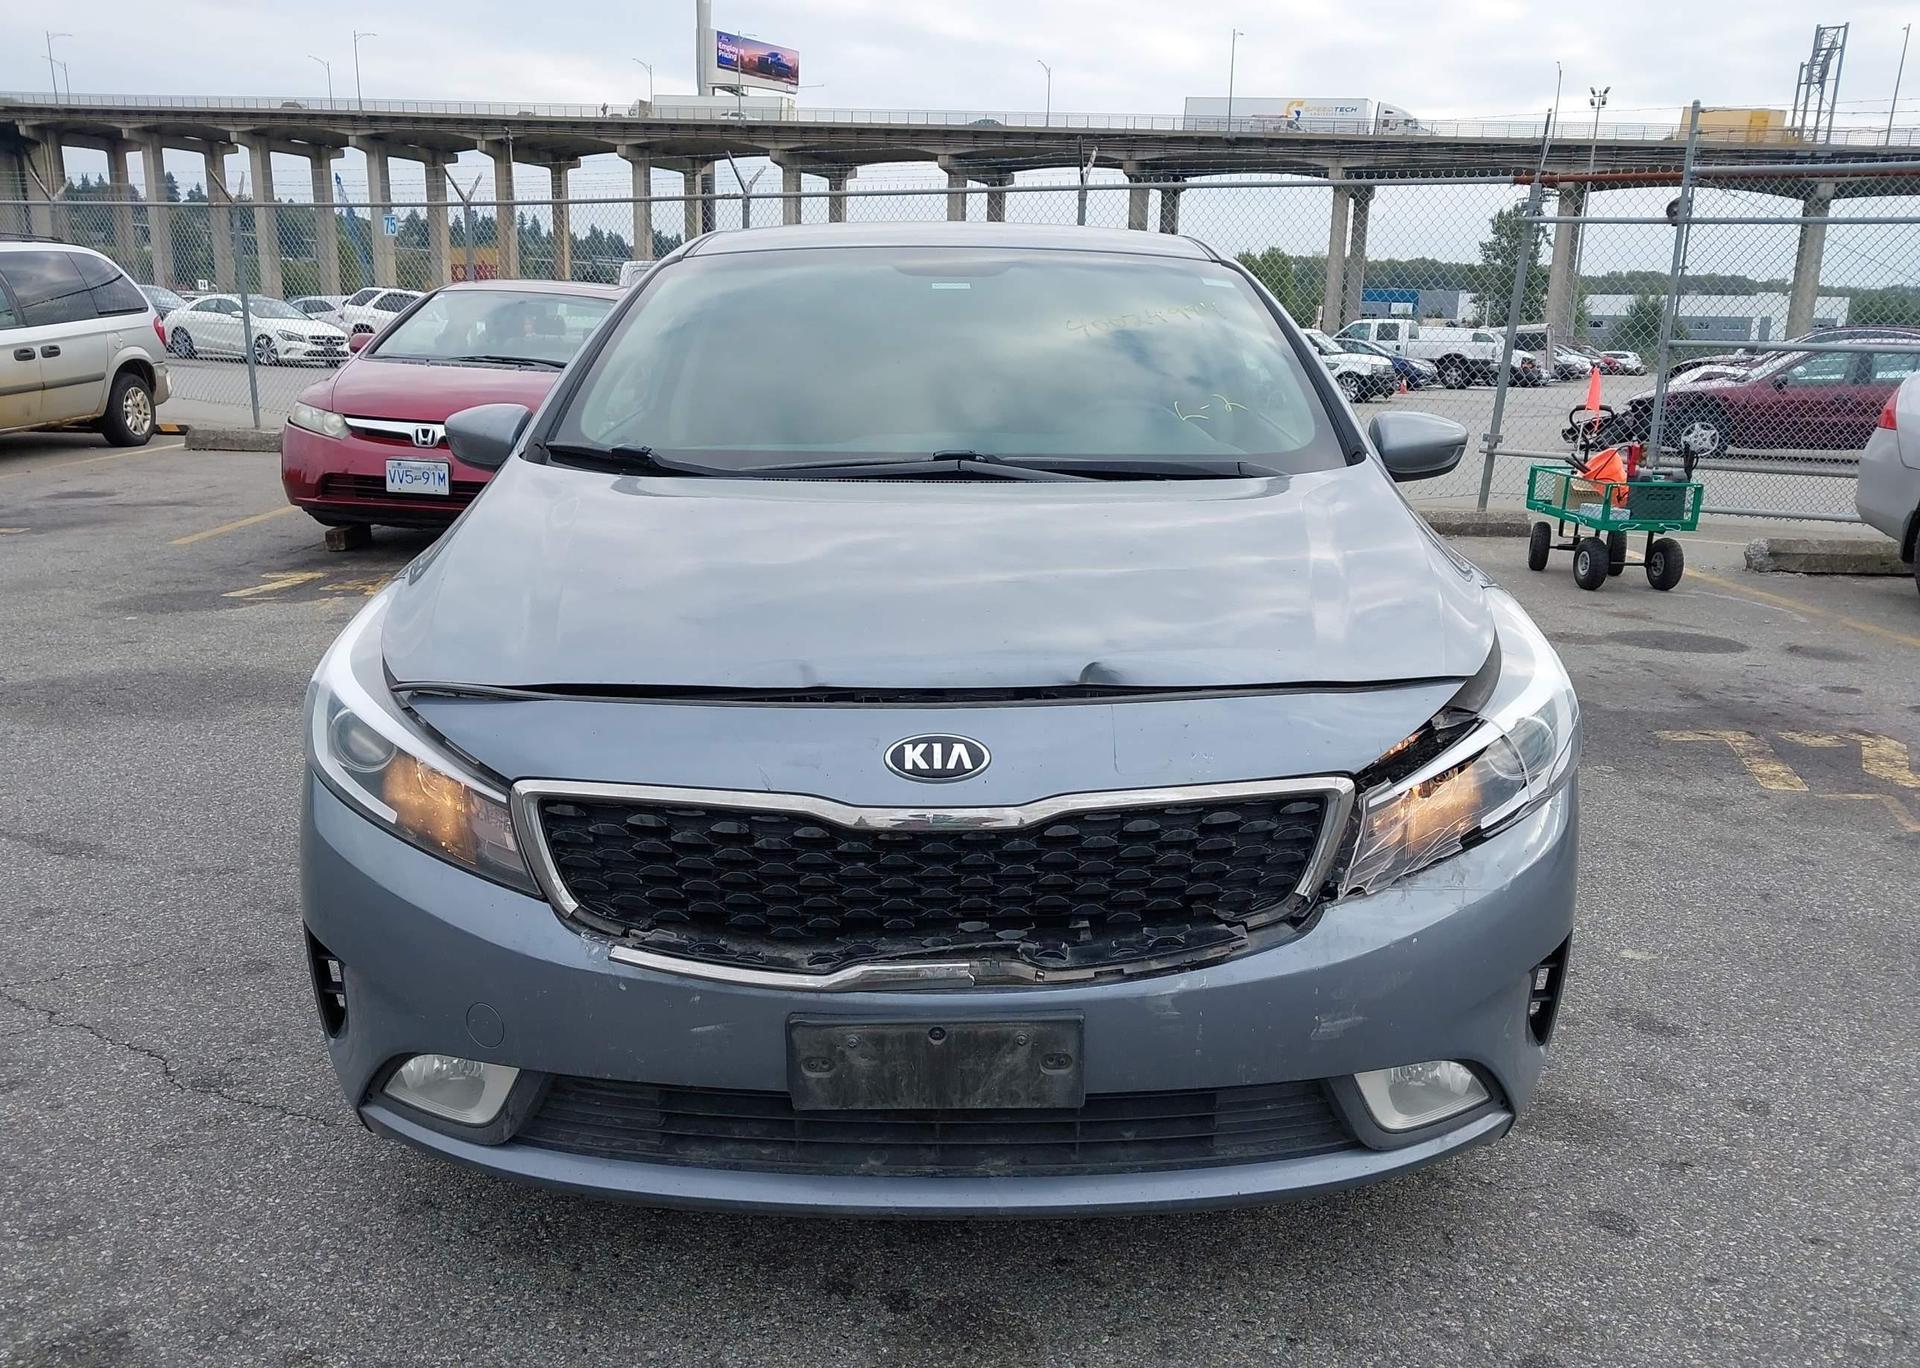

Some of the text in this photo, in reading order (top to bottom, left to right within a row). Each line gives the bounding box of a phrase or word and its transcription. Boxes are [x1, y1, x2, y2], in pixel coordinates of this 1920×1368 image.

[718, 49, 737, 61] Pricing
[384, 216, 396, 234] 75
[903, 742, 974, 770] KIA
